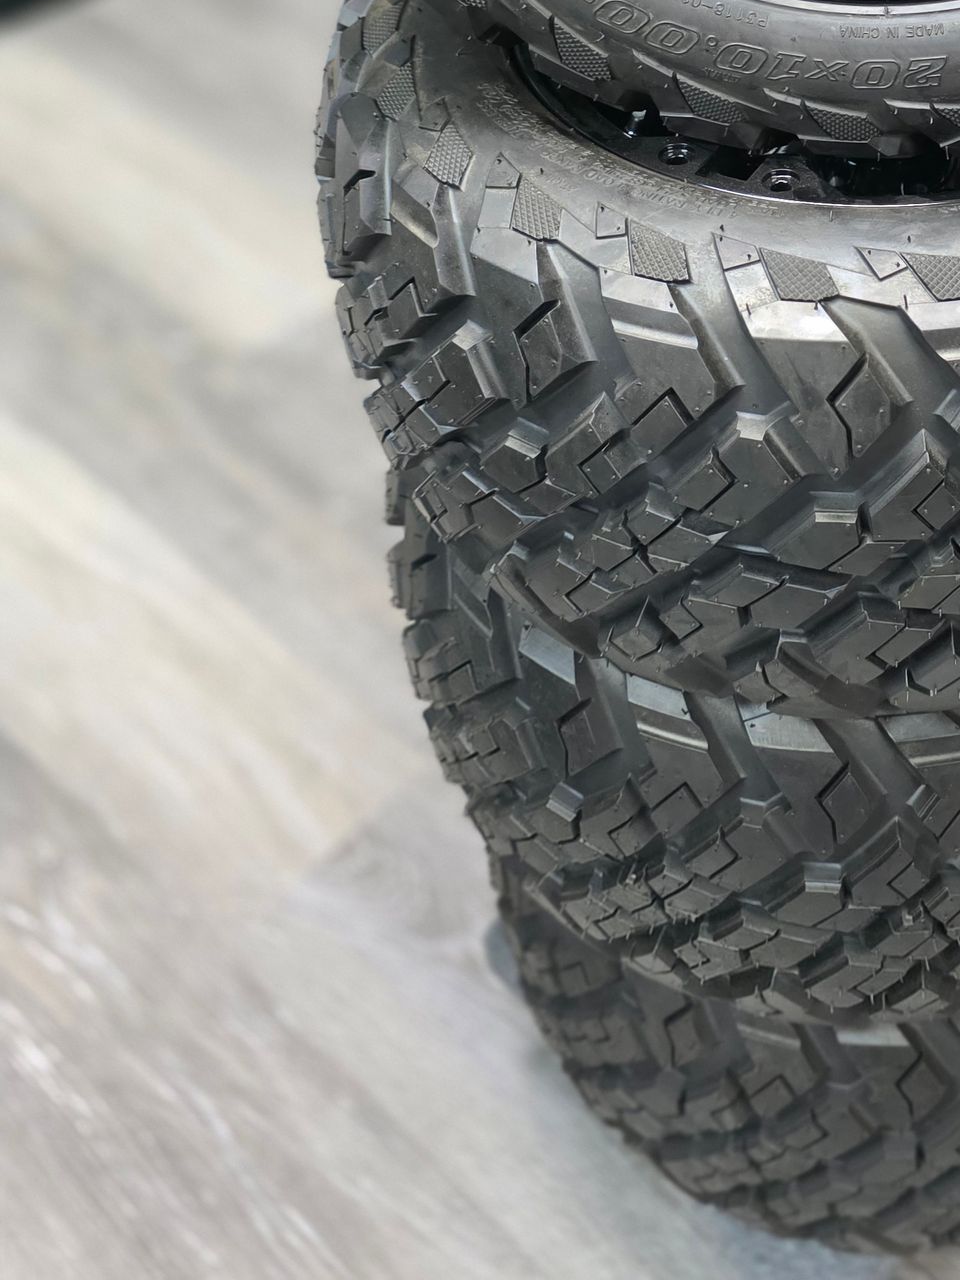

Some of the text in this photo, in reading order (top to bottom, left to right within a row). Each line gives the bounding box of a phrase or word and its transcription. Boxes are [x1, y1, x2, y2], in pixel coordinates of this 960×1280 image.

[838, 21, 943, 39] MADE IN CHINA
